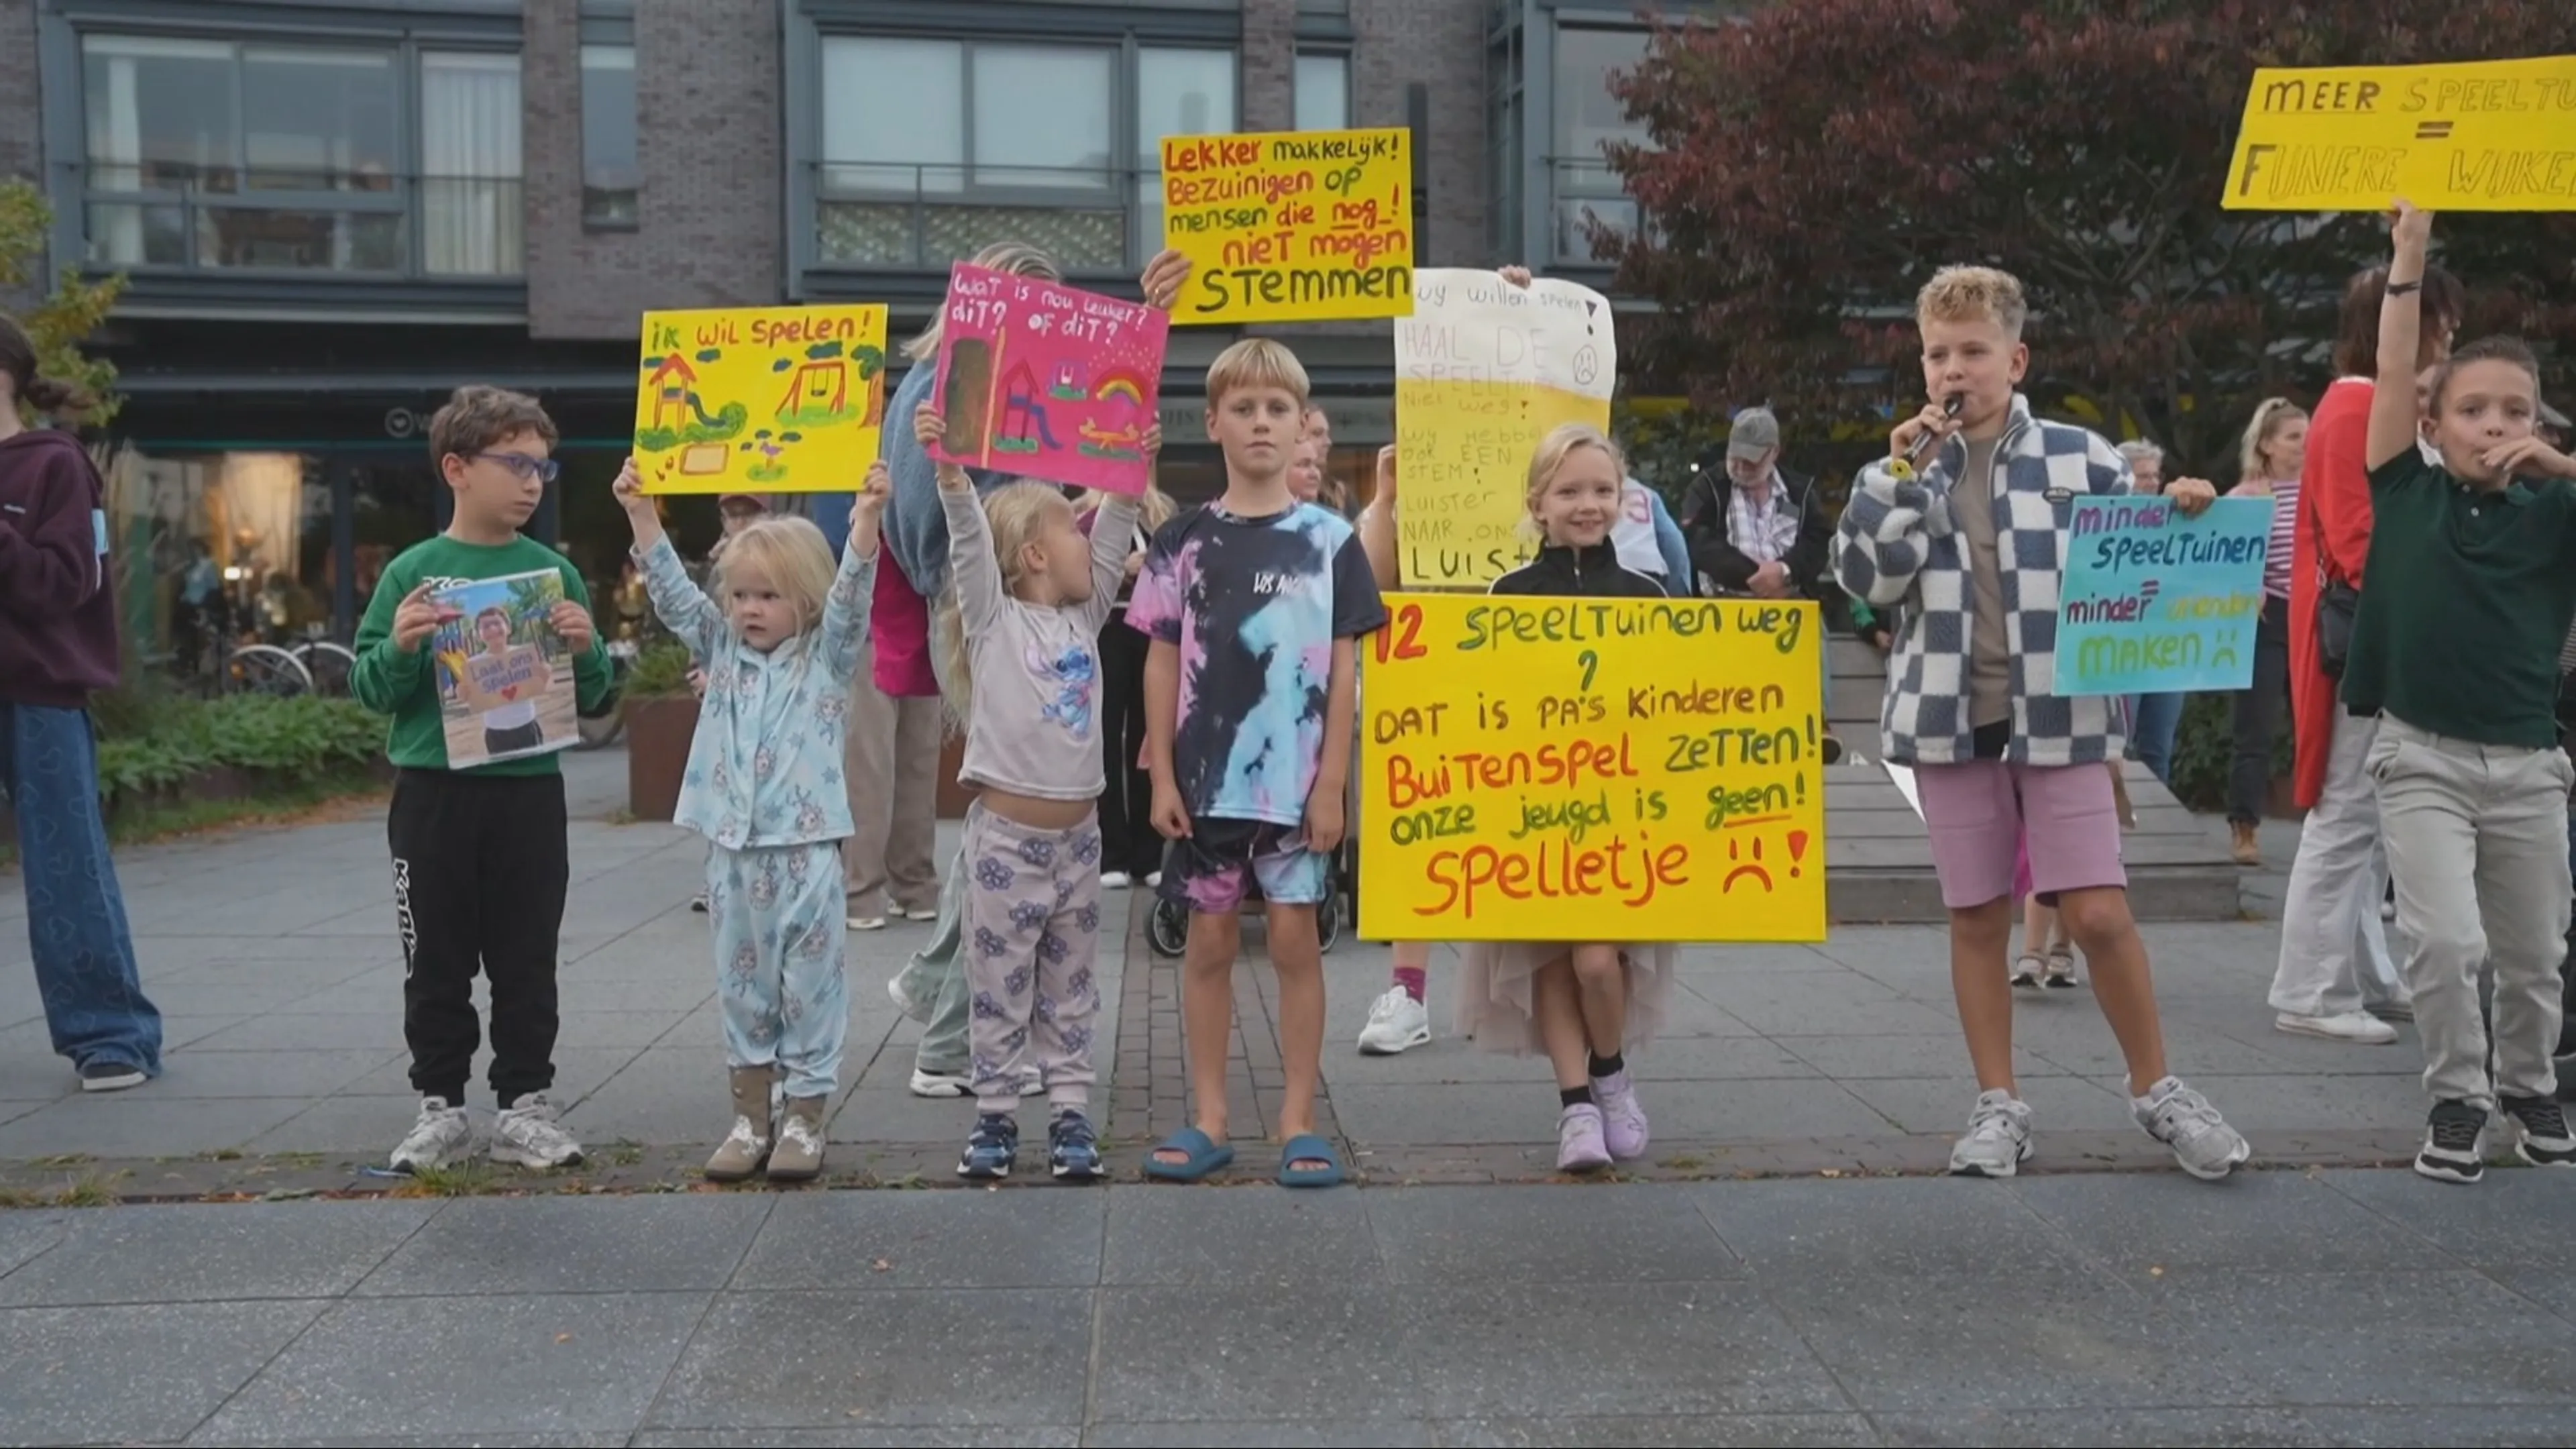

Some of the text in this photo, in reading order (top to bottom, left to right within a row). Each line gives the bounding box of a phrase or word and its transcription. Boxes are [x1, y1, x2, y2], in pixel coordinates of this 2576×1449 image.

[1170, 207, 1267, 234] mensen
[1276, 201, 1315, 227] die
[1309, 229, 1407, 270] mogen
[1014, 279, 1029, 301] is
[1040, 291, 1074, 310] nou
[1497, 325, 1552, 370] DE
[2067, 591, 2152, 626] minder
[1373, 603, 1428, 664] 12
[1737, 606, 1803, 654] weg
[1374, 702, 1449, 745] DAT
[1477, 691, 1509, 731] is
[1389, 803, 1476, 847] onze
[1508, 788, 1612, 845] jeugd
[1635, 788, 1668, 822] is
